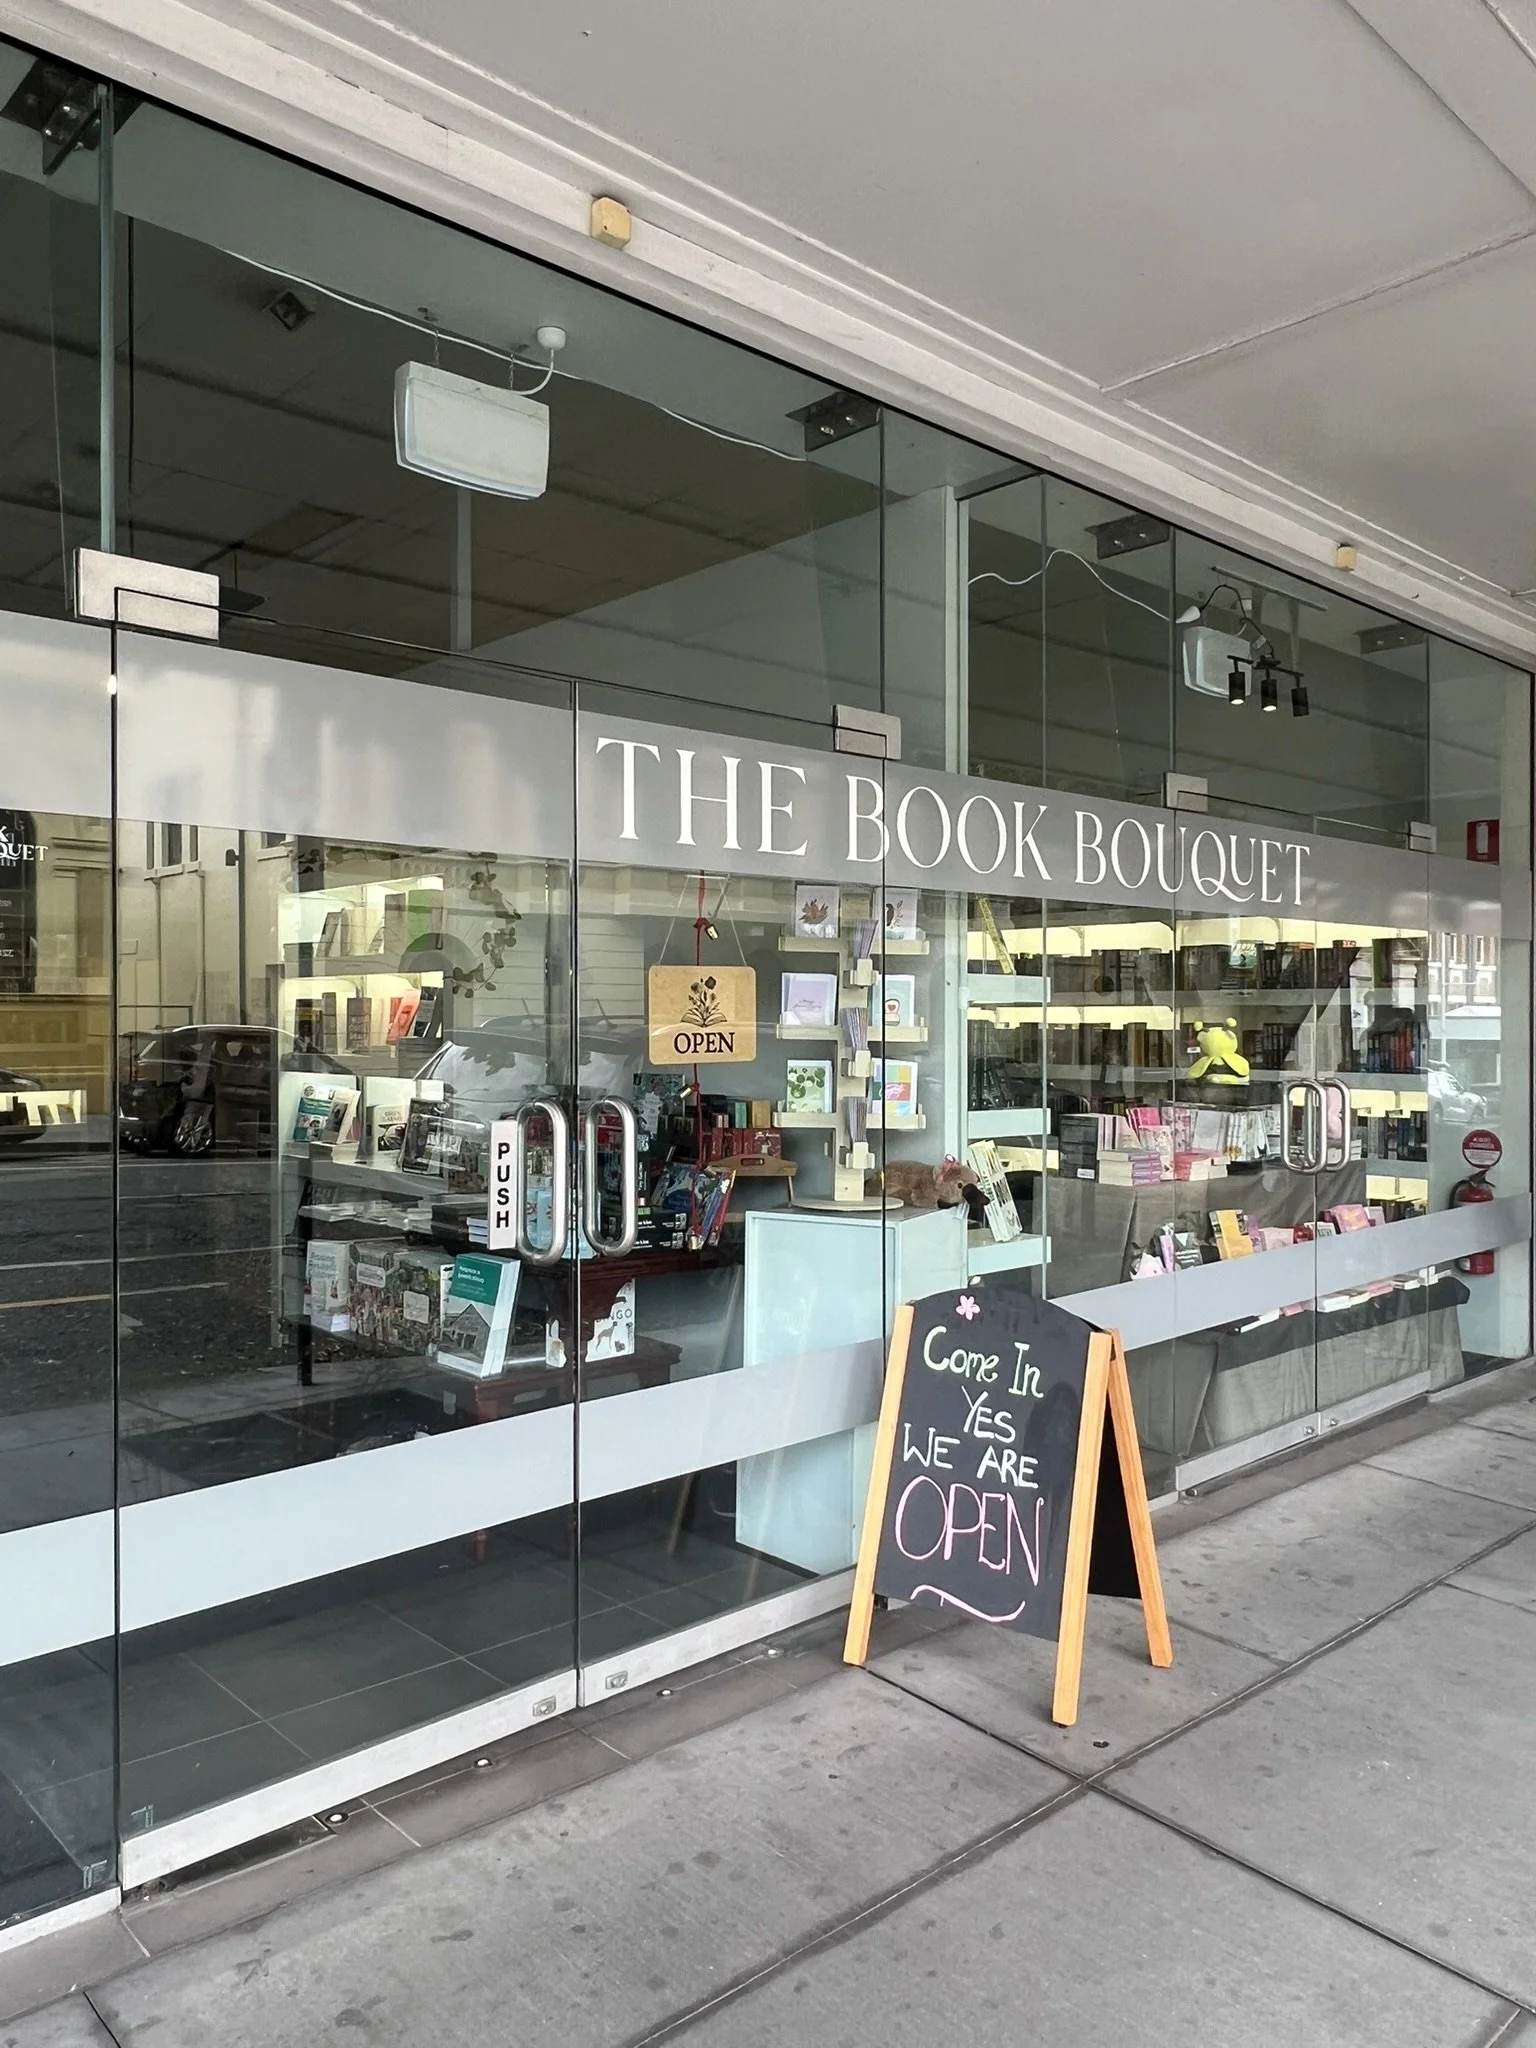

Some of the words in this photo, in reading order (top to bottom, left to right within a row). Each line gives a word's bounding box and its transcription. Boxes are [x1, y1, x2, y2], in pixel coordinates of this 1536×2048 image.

[596, 736, 808, 857] THE
[846, 775, 1051, 881] BOOK
[1075, 810, 1311, 905] BOUQUET
[673, 1031, 736, 1055] OPEN
[496, 1142, 510, 1229] PUSH
[923, 1325, 999, 1383] Come
[1008, 1341, 1044, 1398] In
[961, 1385, 1016, 1443] YES
[903, 1422, 961, 1469] WE
[977, 1445, 1039, 1489] ARE
[894, 1475, 1045, 1586] OPEN
